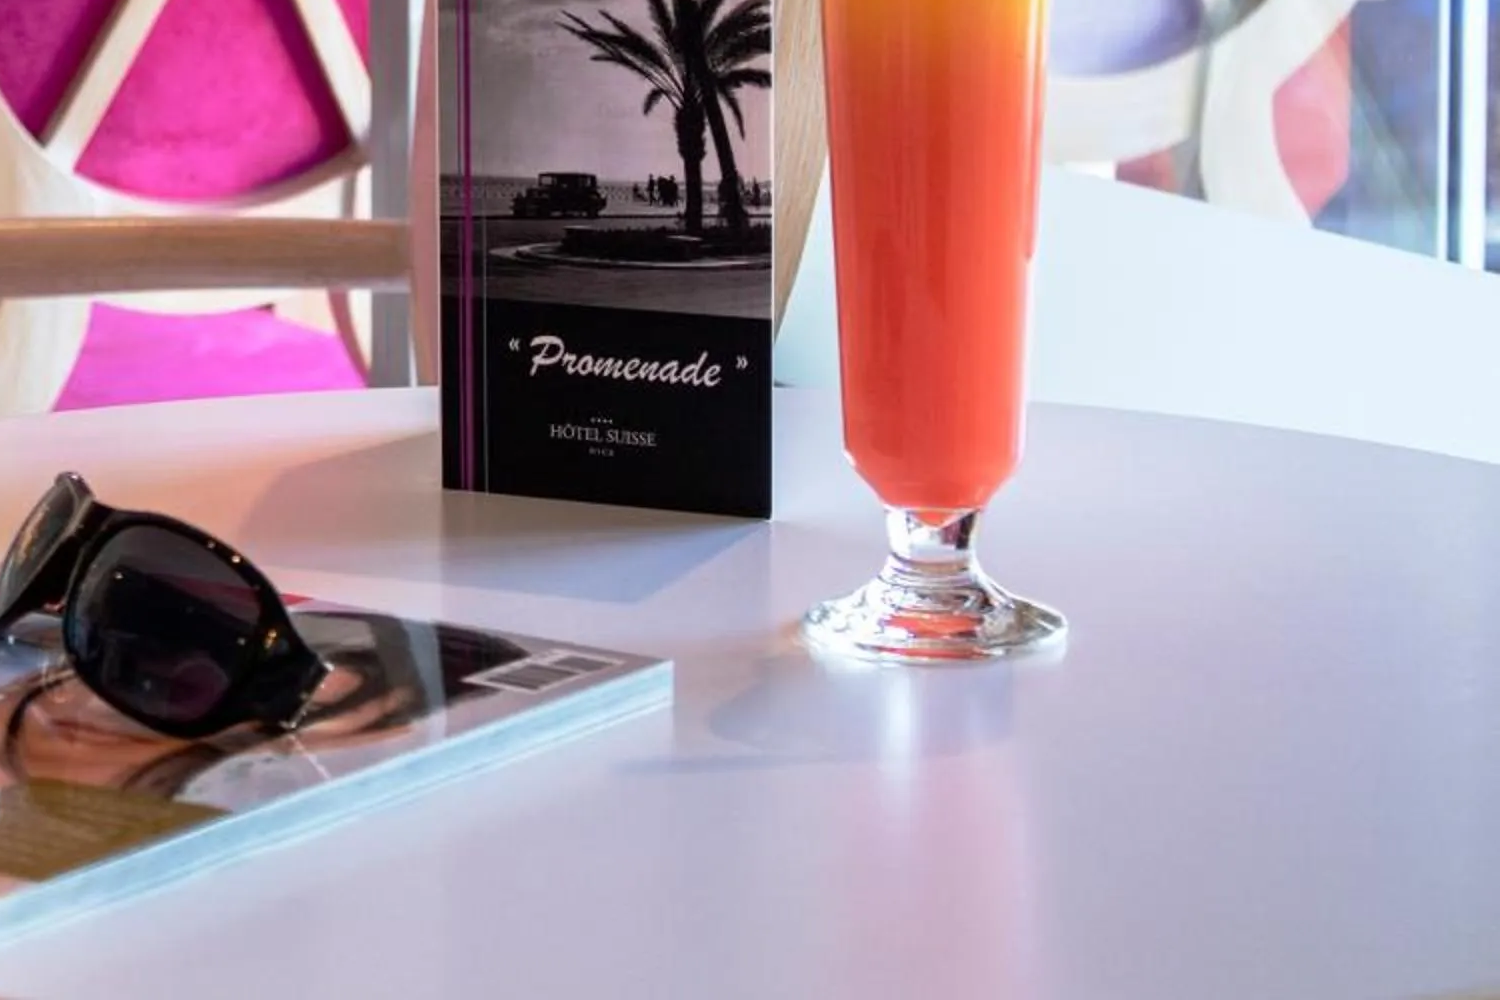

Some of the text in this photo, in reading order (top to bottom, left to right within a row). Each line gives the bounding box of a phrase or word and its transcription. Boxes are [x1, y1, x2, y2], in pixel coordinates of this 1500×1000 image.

[529, 335, 723, 387] Promenade
[549, 422, 658, 447] HÔTEL SUISSE
